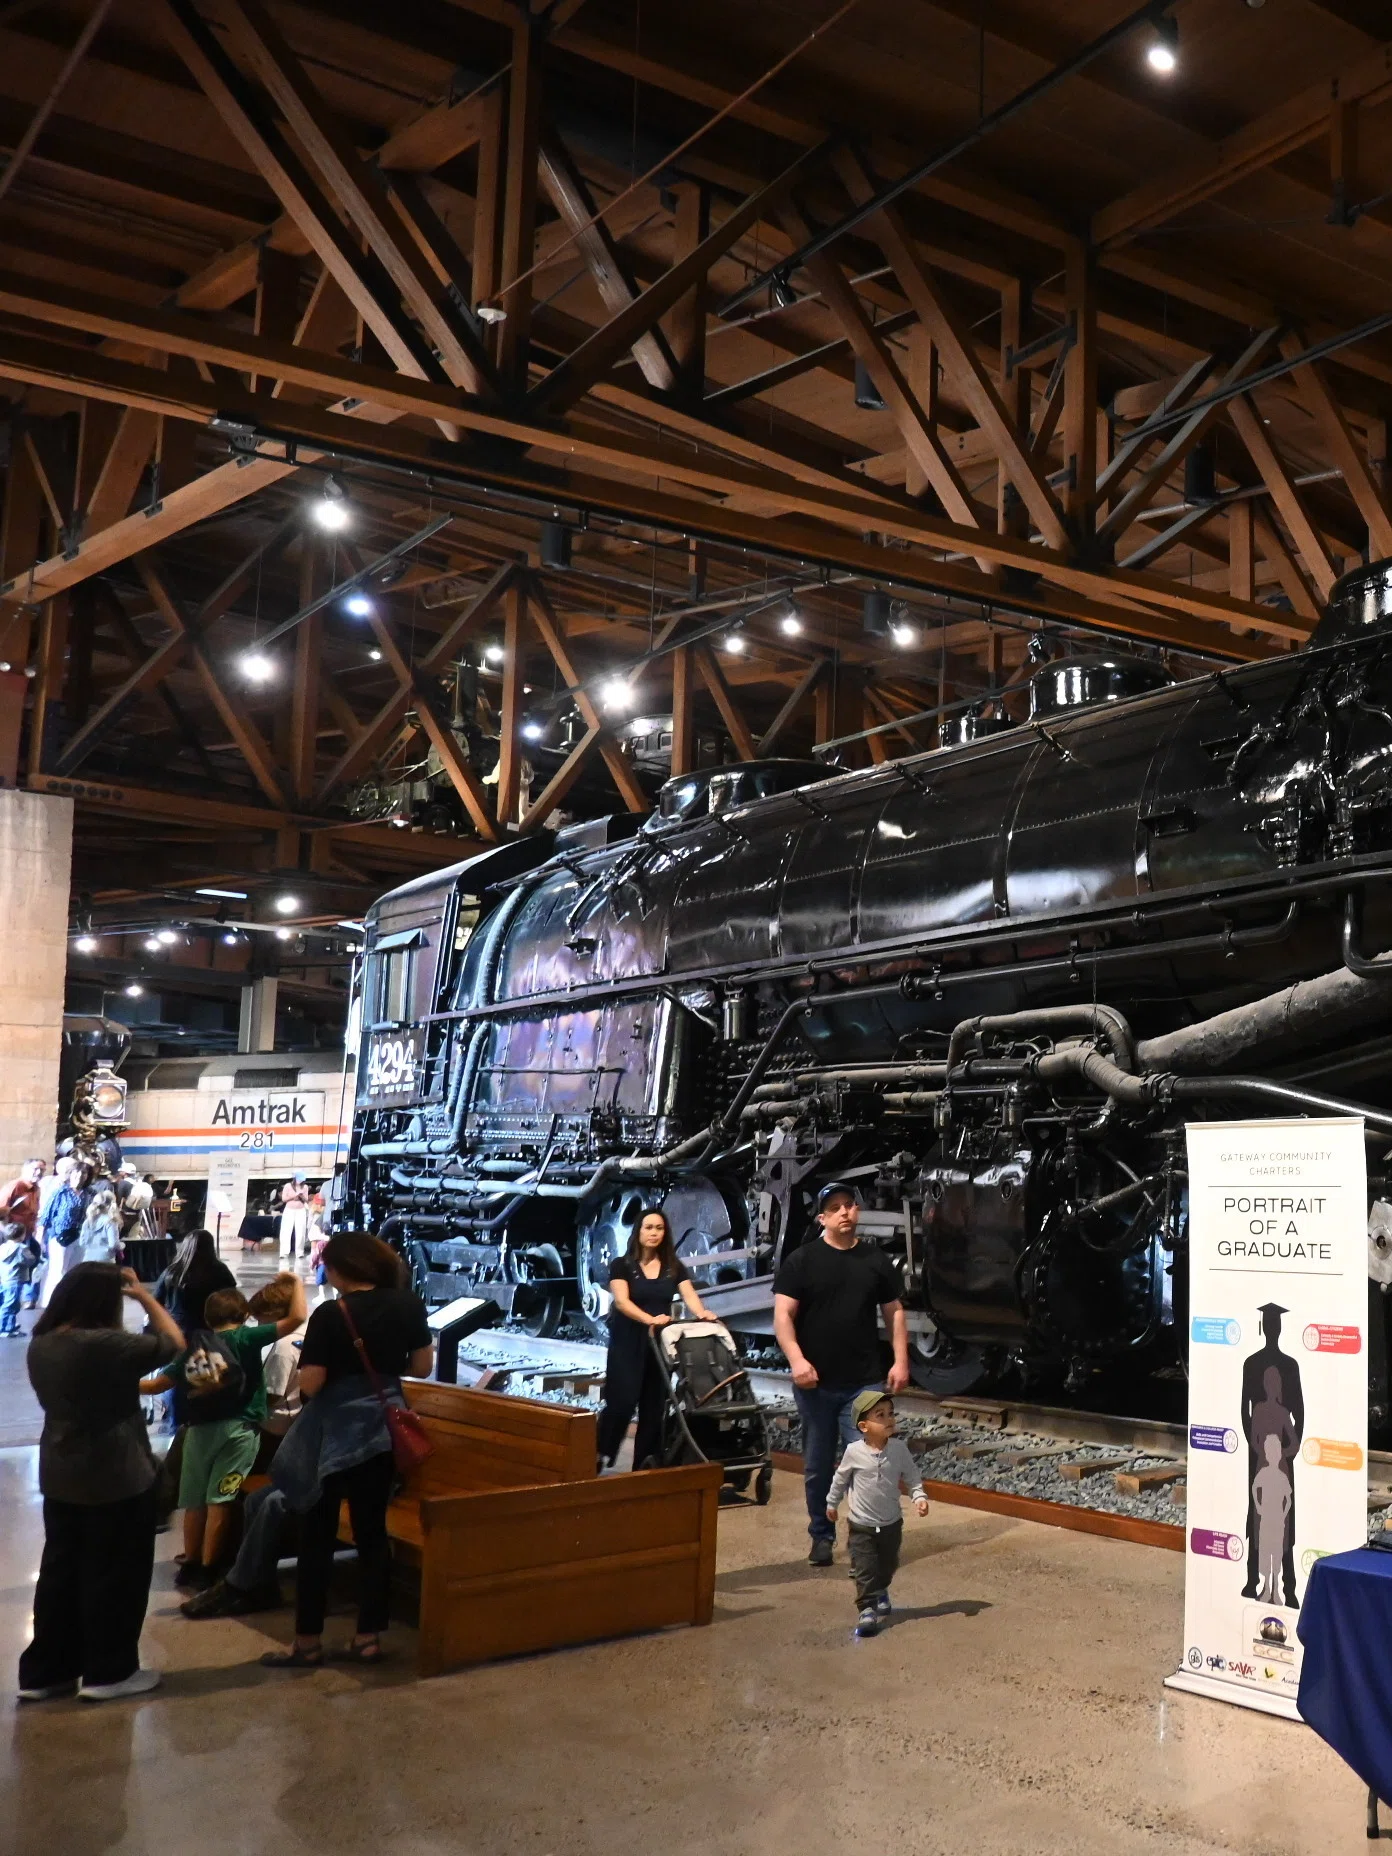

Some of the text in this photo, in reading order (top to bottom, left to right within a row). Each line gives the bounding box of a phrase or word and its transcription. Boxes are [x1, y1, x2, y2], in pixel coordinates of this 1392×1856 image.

[369, 1039, 416, 1084] 4294
[211, 1097, 306, 1125] Amtrak
[240, 1131, 275, 1149] 281
[1220, 1151, 1333, 1162] GATEWAY COMMUNITY
[1249, 1166, 1302, 1176] CHARTERS
[1224, 1197, 1327, 1214] PORTRAIT
[1249, 1219, 1299, 1236] OF A
[1217, 1240, 1332, 1259] GRADUATE
